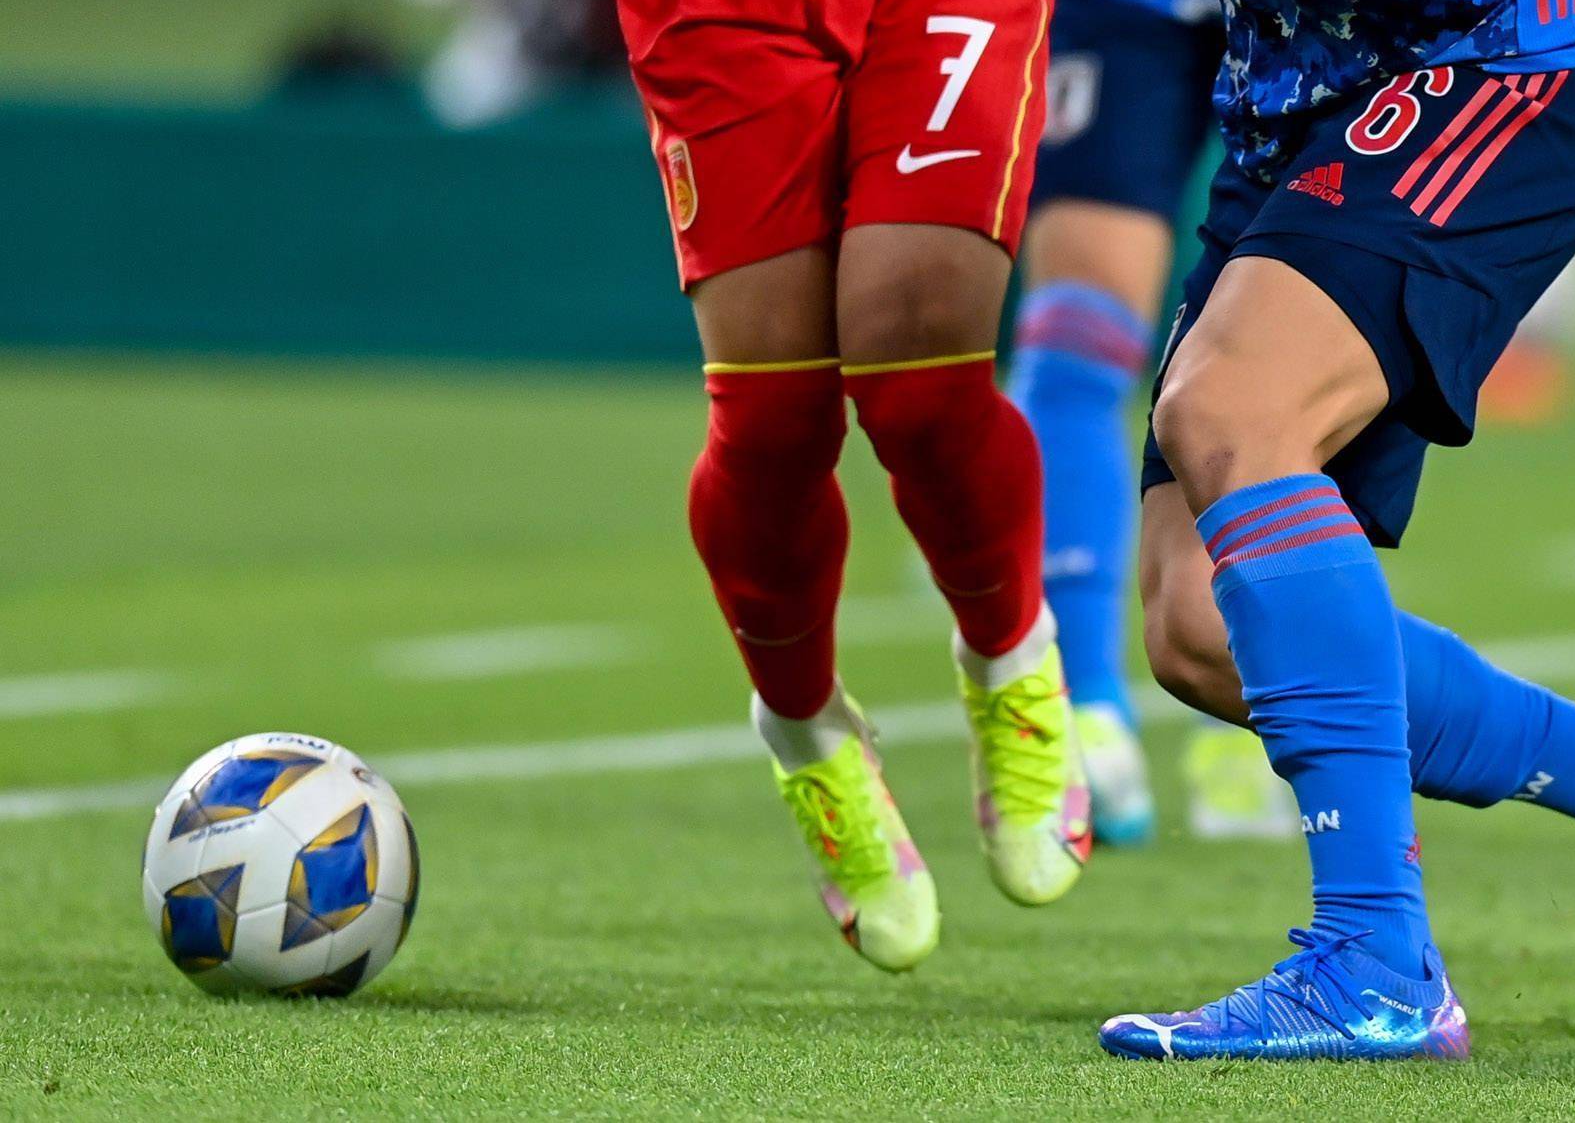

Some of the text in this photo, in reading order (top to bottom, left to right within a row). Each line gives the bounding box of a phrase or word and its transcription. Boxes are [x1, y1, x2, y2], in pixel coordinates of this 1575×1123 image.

[926, 15, 996, 132] 7
[1345, 65, 1454, 156] 6
[1379, 994, 1416, 1016] WATARU
